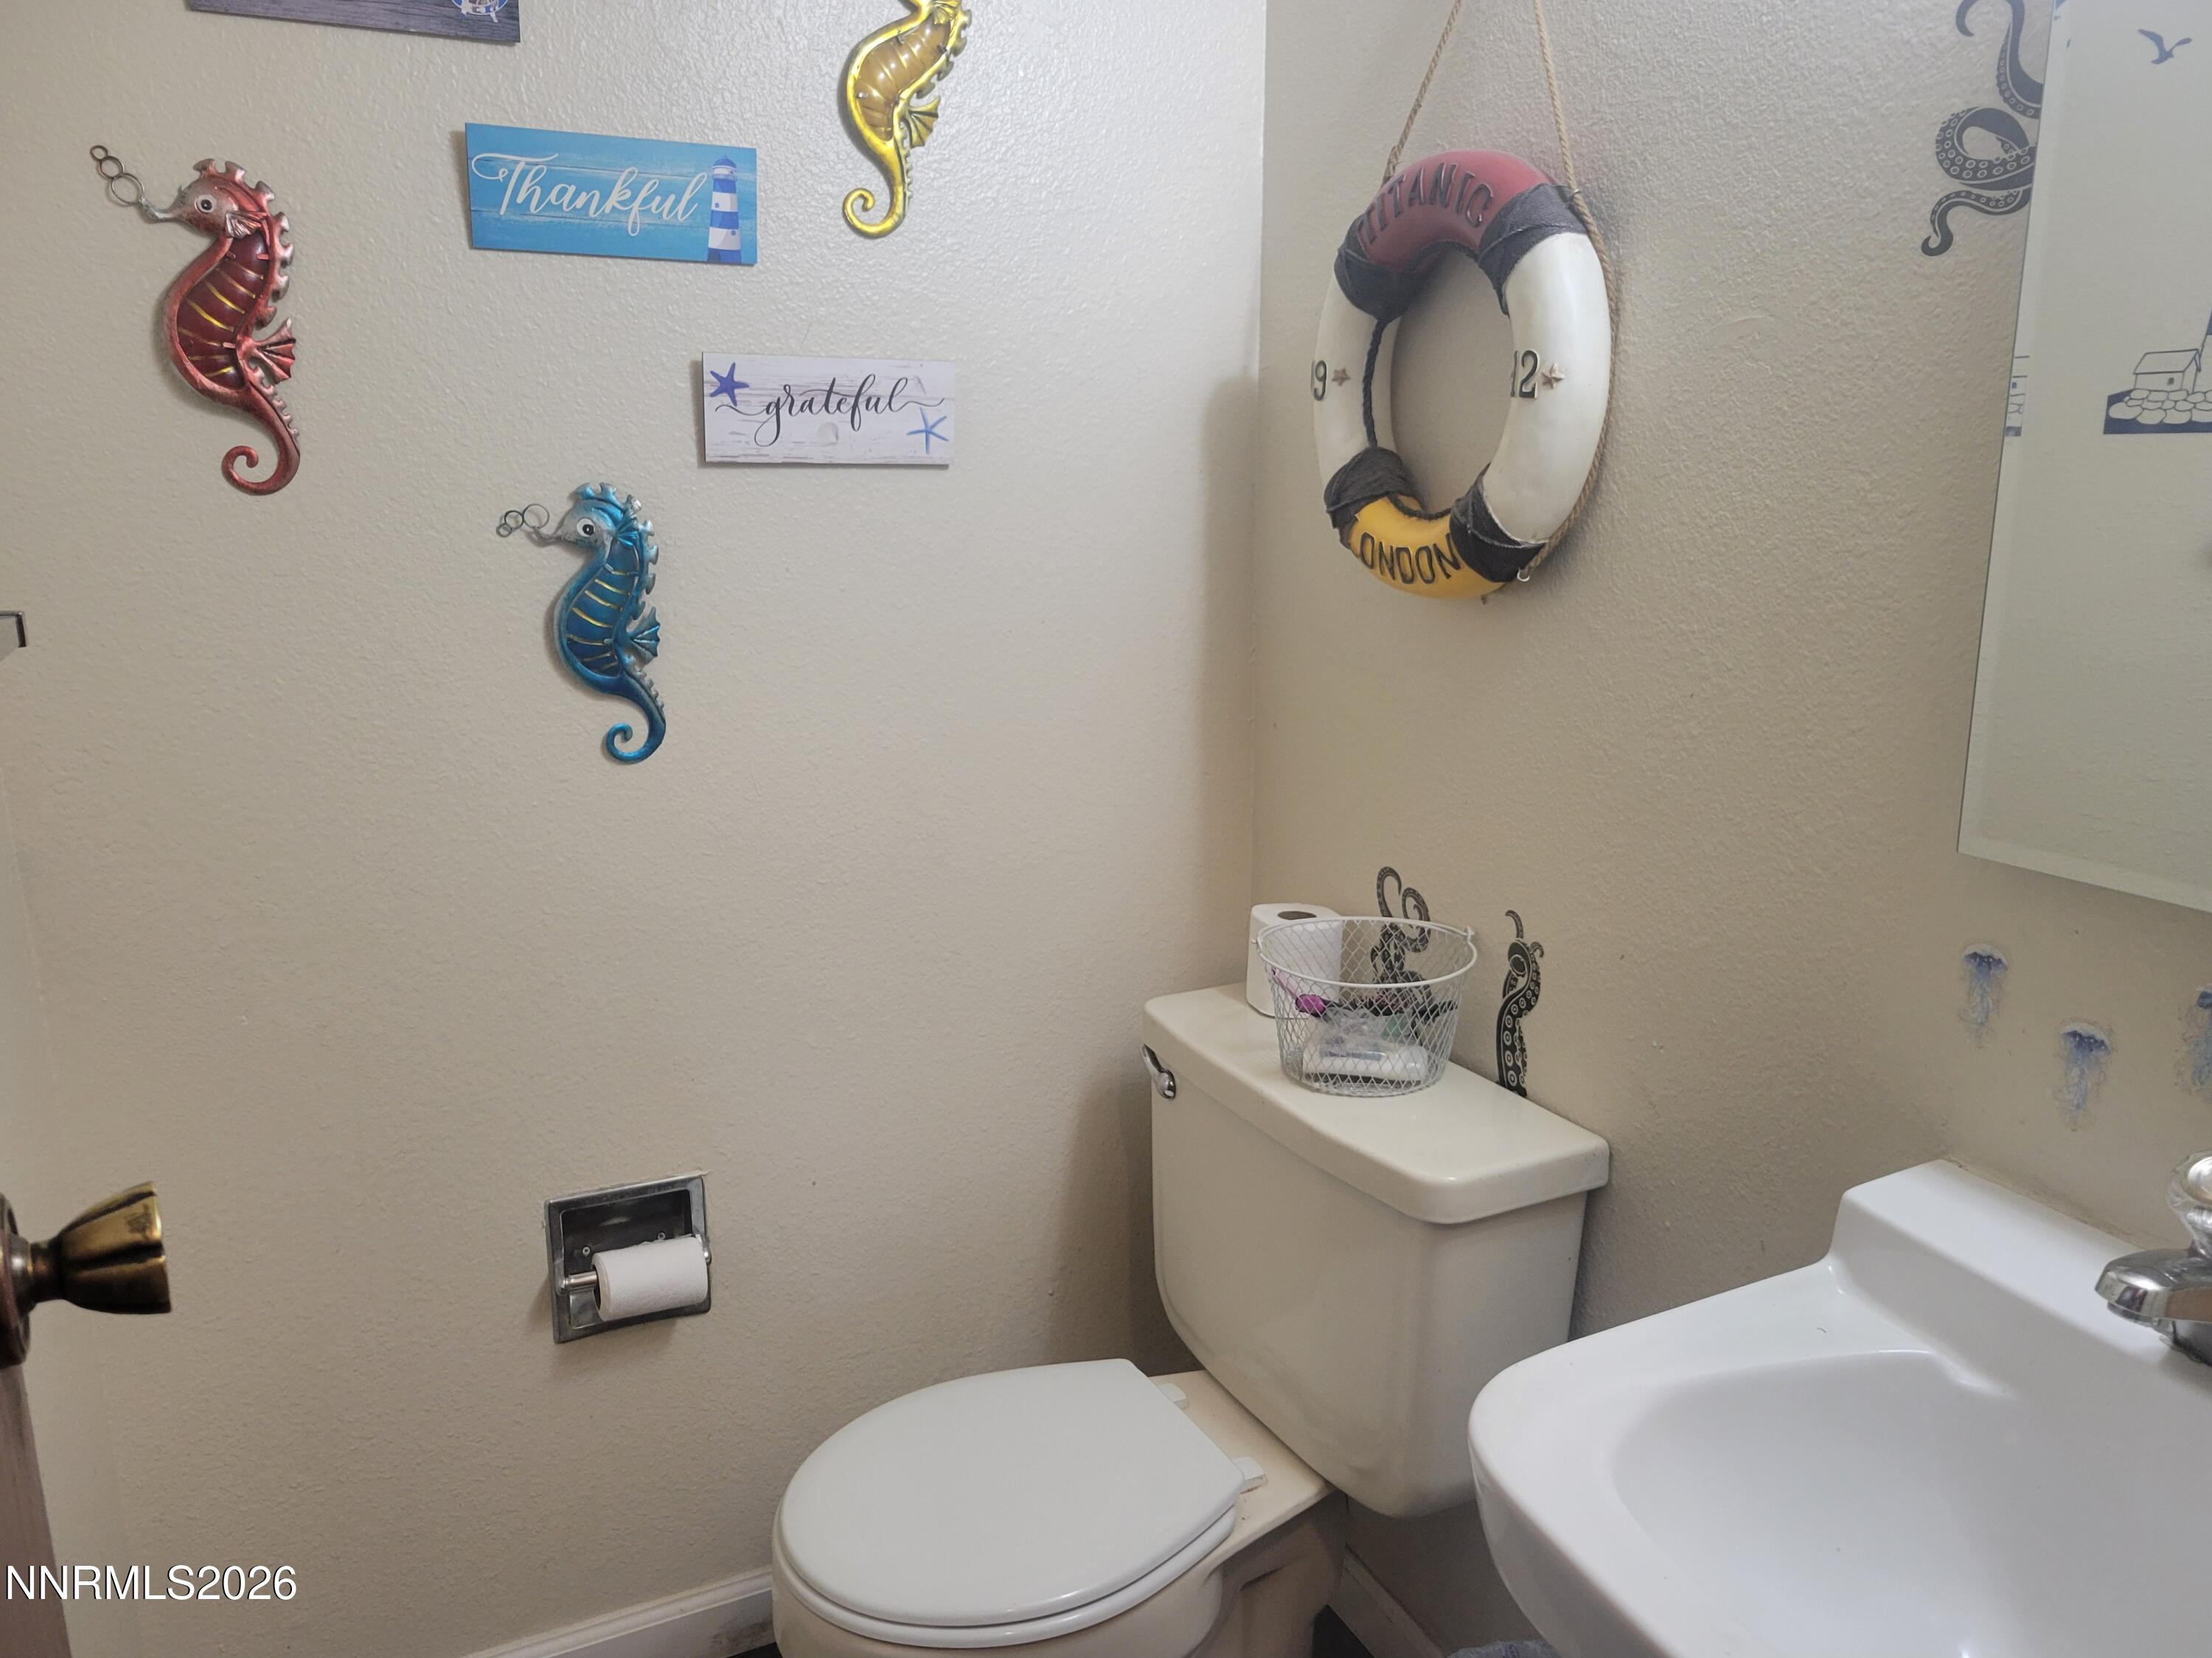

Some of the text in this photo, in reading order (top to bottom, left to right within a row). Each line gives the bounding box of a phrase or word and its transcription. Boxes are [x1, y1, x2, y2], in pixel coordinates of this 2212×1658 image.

[472, 153, 708, 236] Thankful
[1357, 161, 1494, 245] TITANIC
[715, 374, 945, 447] grateful
[1509, 349, 1539, 399] 12
[1359, 532, 1461, 585] ONDON
